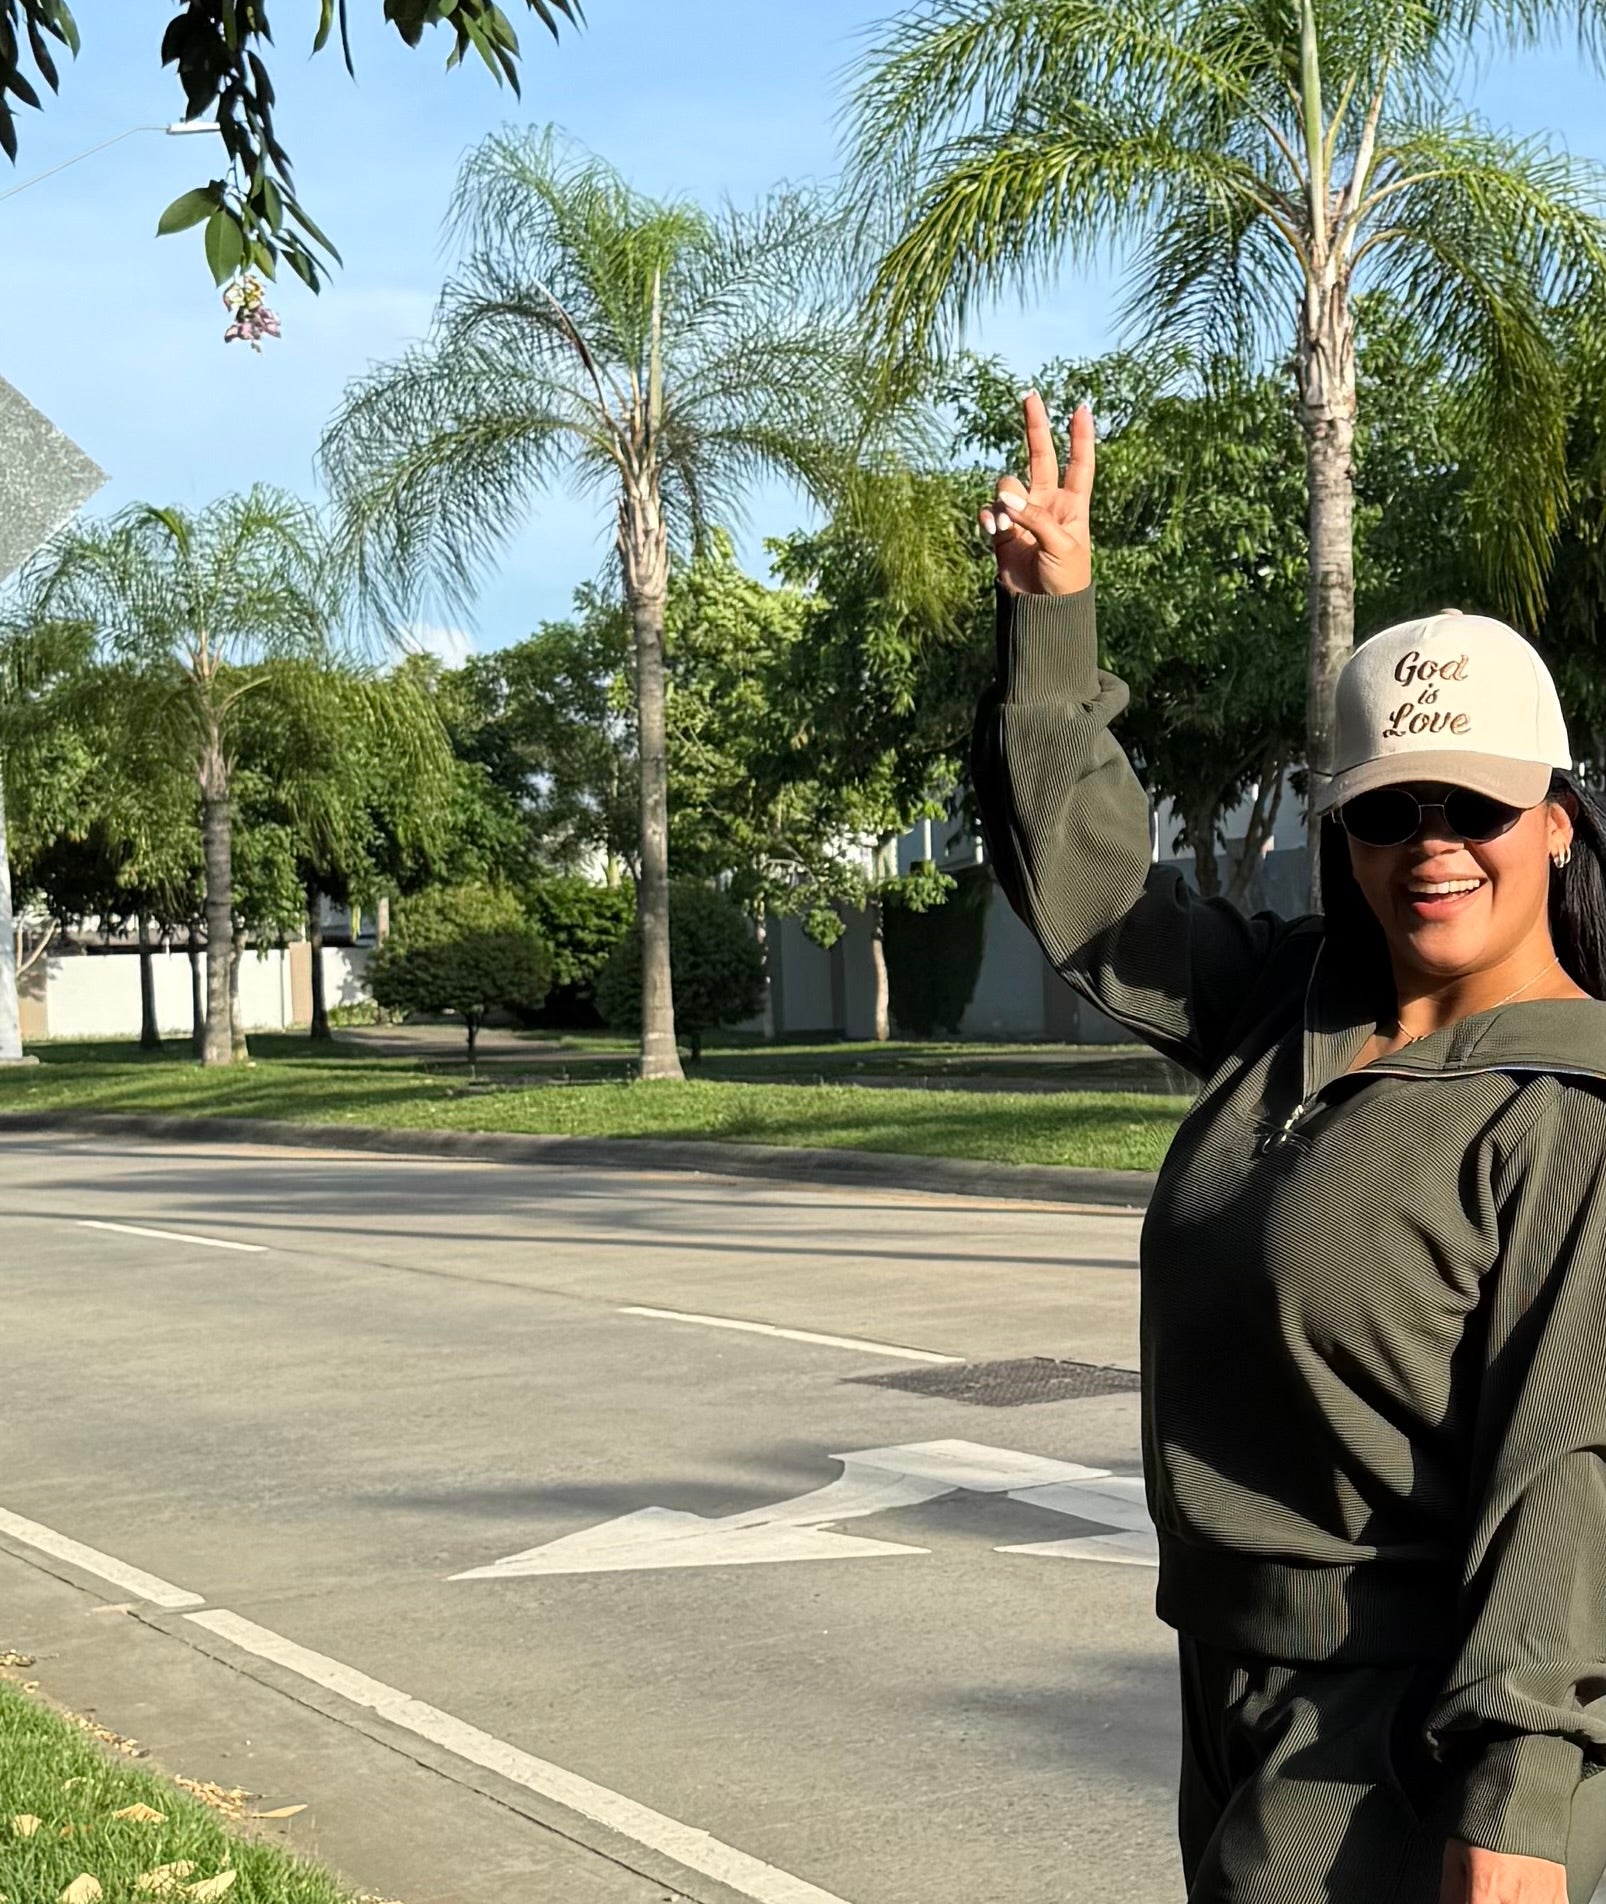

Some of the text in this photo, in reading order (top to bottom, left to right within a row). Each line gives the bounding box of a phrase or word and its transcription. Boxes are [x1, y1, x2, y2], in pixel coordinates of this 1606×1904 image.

[1394, 651, 1469, 687] God
[1417, 683, 1440, 704] is
[1383, 703, 1472, 738] Love
